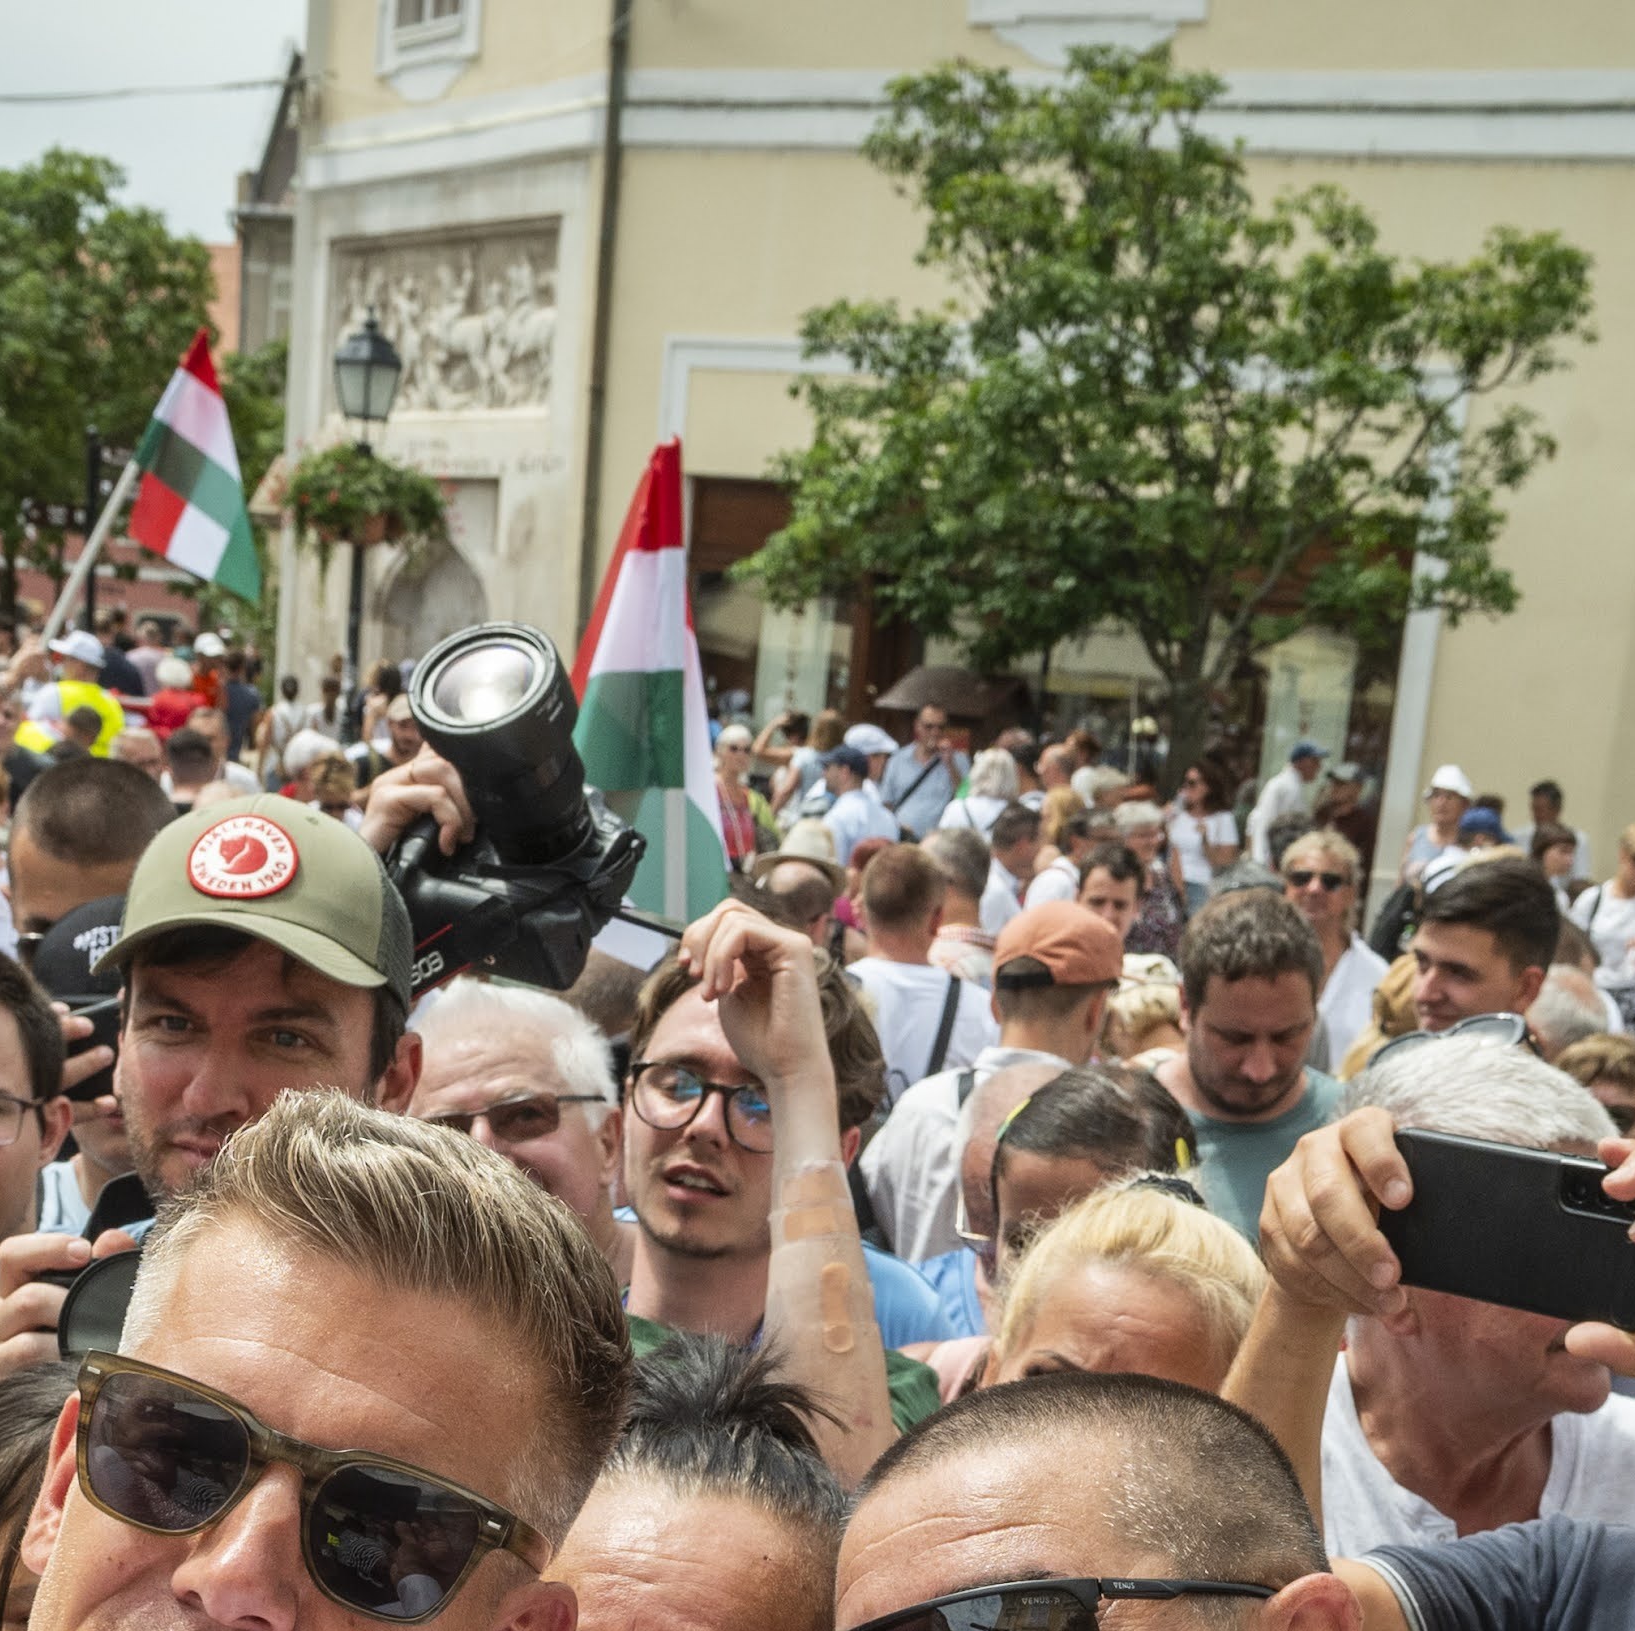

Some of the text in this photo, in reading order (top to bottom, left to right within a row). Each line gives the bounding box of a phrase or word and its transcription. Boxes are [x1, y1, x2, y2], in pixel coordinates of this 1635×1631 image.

[195, 861, 288, 890] SWEDEN 1960
[1112, 1581, 1136, 1590] VENUS
